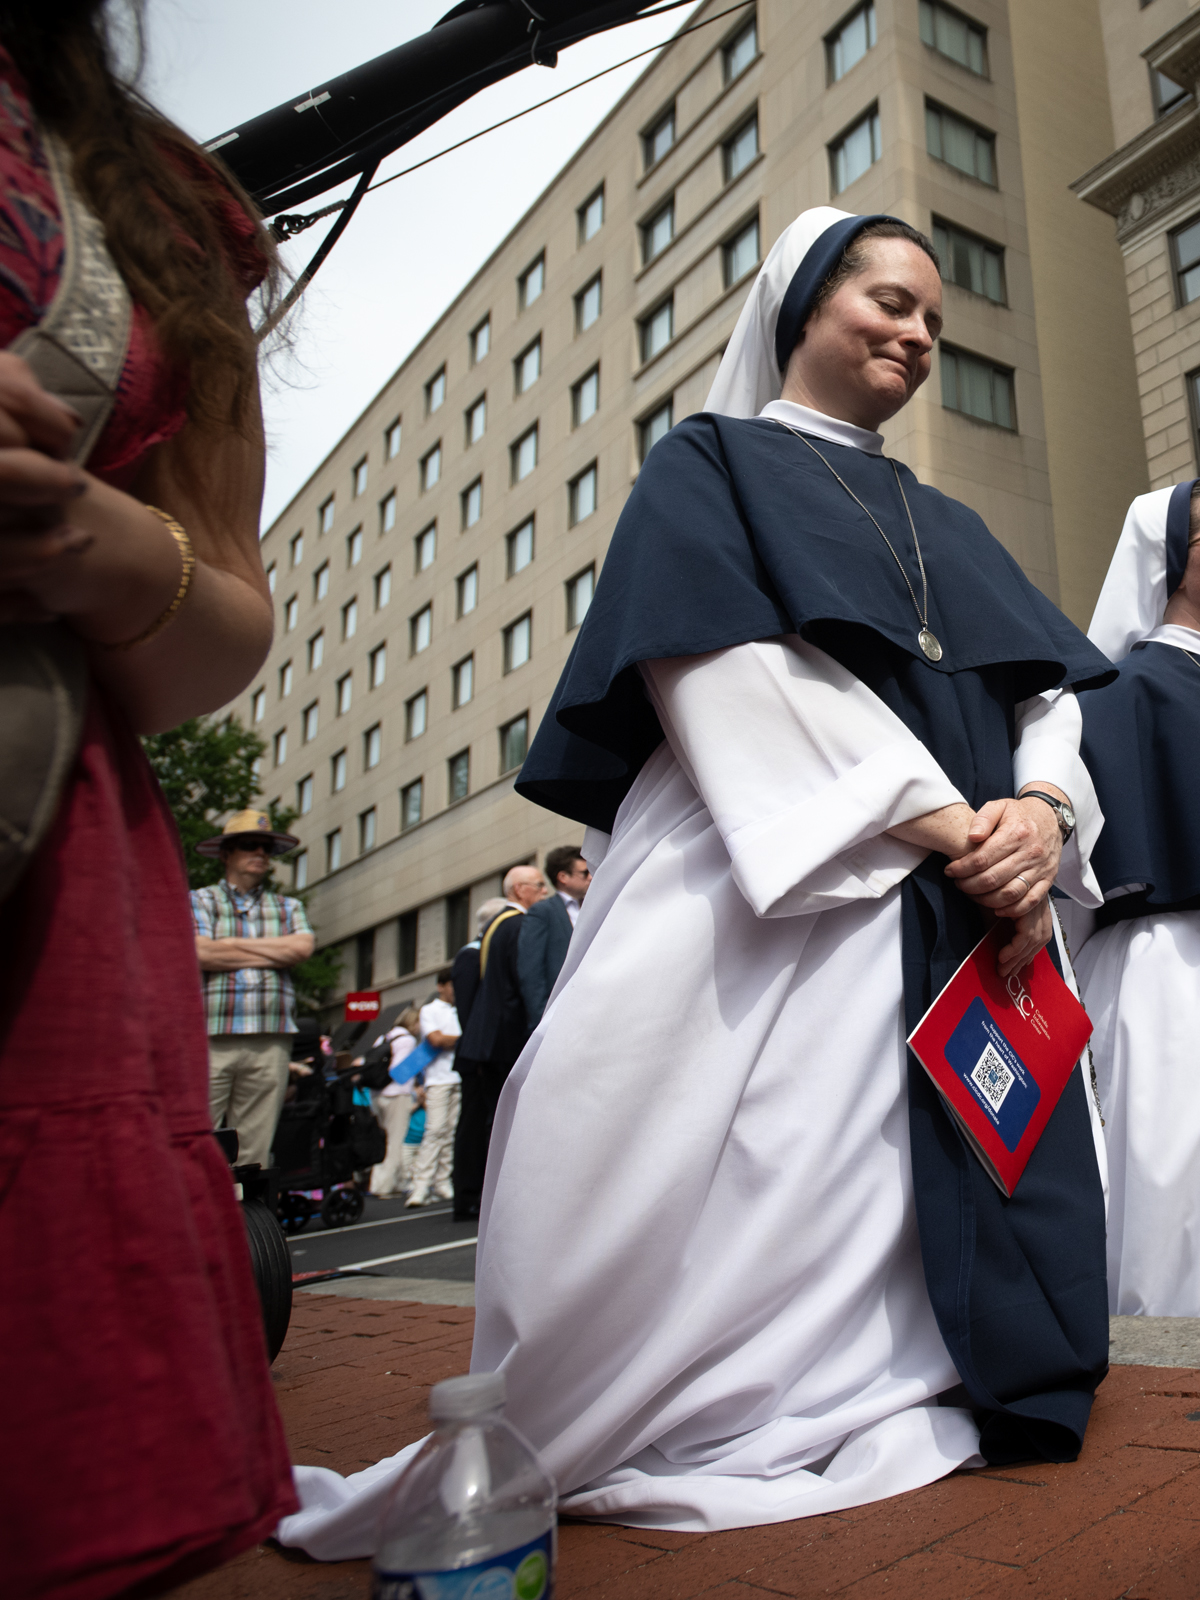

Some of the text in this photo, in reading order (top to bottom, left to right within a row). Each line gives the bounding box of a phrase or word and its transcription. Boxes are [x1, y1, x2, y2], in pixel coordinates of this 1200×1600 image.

[1008, 974, 1034, 1017] CIC
[1033, 1013, 1051, 1040] Information
[1035, 1009, 1049, 1029] Catholic
[981, 1020, 991, 1034] from
[995, 1041, 1005, 1055] heart
[990, 1023, 1004, 1044] Support
[1016, 1062, 1026, 1075] work
